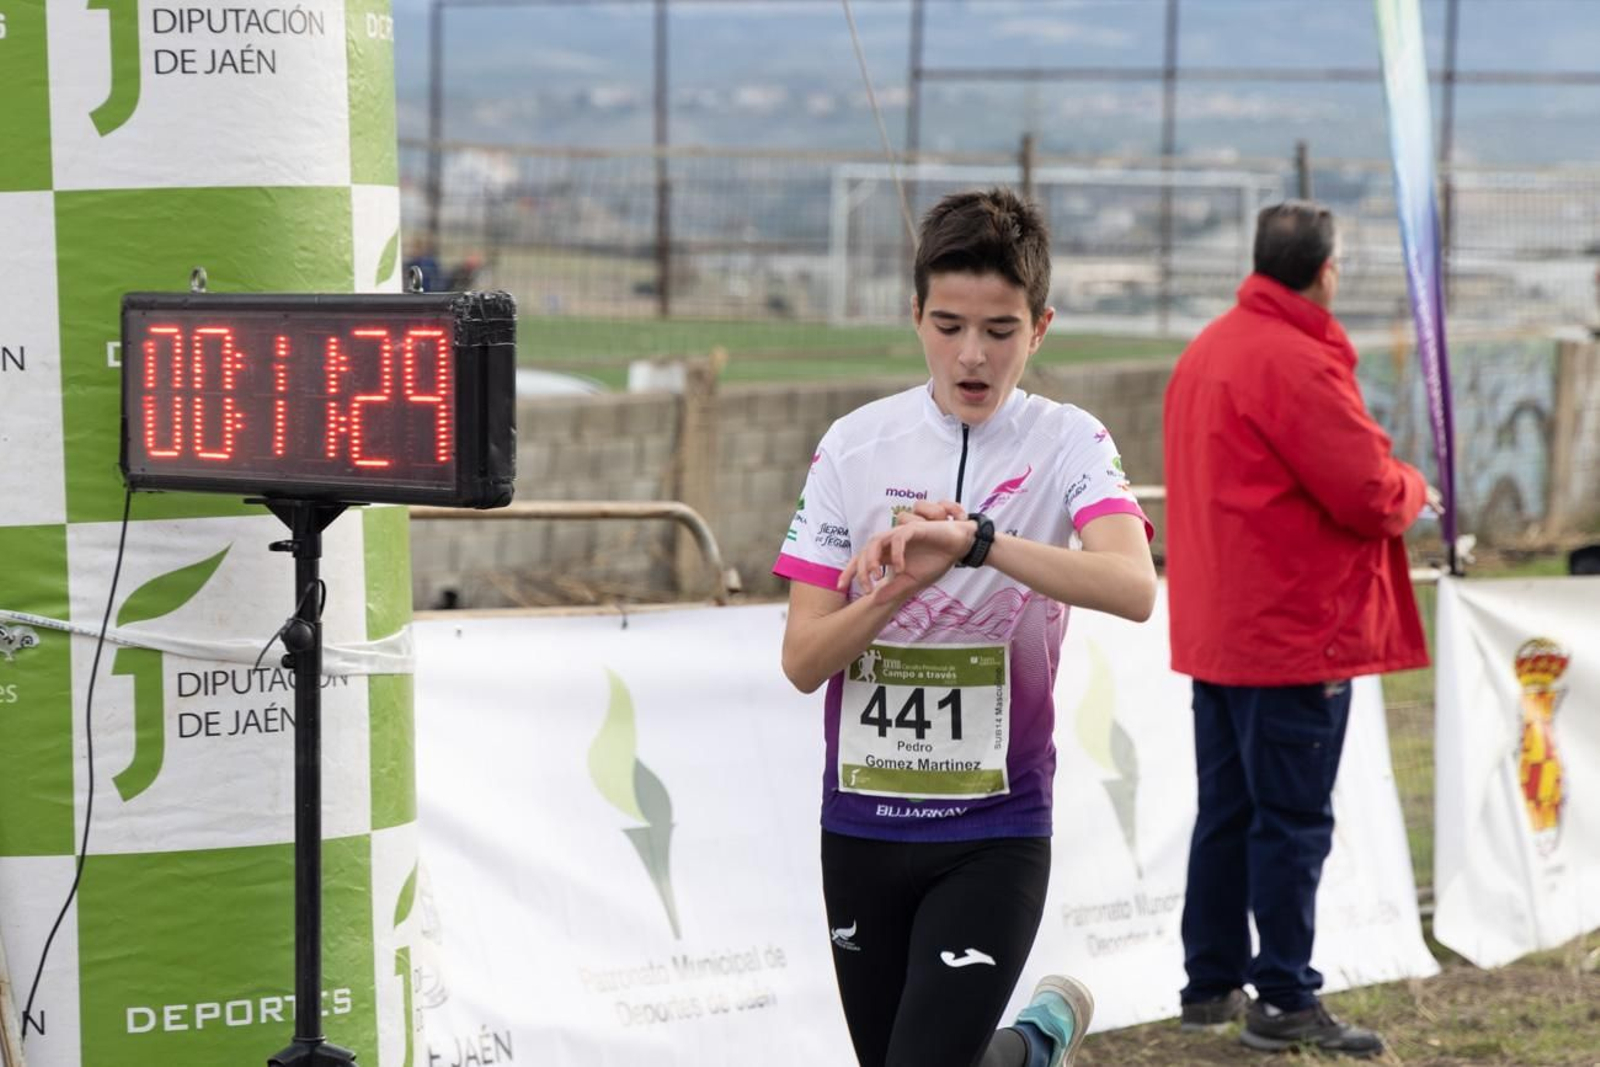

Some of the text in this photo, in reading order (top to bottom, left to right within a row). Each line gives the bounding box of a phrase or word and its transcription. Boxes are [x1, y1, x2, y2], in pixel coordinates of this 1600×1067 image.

[152, 4, 325, 35] DIPUTACIÓN
[154, 43, 277, 75] DE JAÉN
[883, 668, 915, 680] Campo
[926, 669, 957, 680] través
[178, 711, 222, 739] DE
[860, 685, 963, 740] 441
[896, 740, 934, 753] Pedro
[865, 754, 982, 772] Gomez Martinez
[126, 987, 352, 1034] DEPORTS
